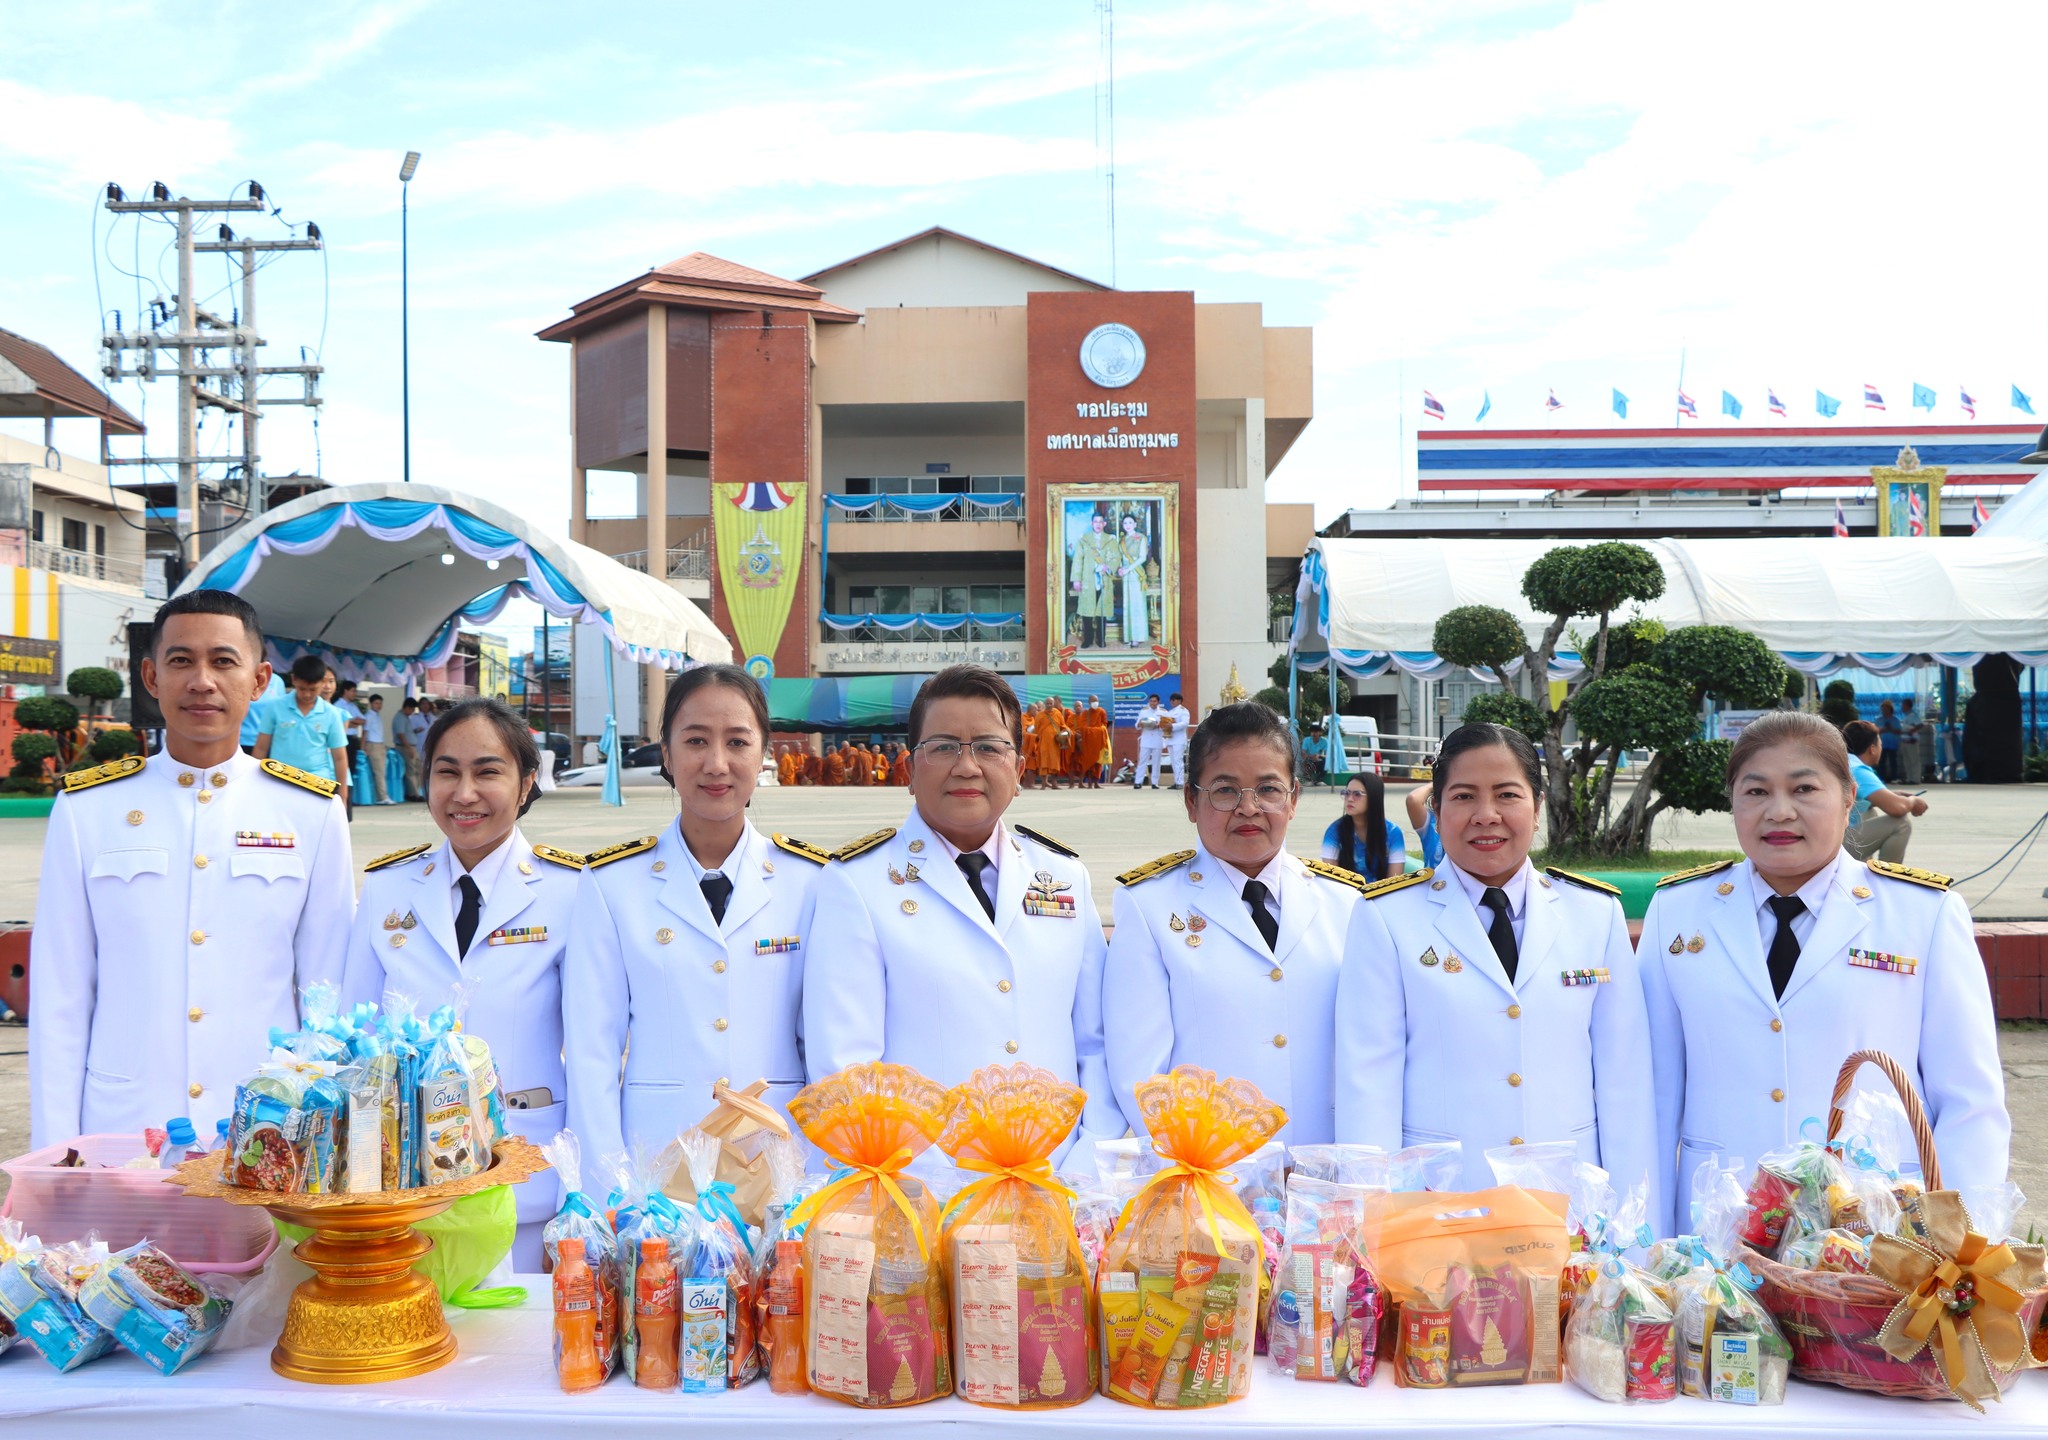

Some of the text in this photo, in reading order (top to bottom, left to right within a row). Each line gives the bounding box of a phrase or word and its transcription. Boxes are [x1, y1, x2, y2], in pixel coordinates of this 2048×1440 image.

[1047, 427, 1178, 457] เทศบาลเมืองชุมพร
[432, 1086, 462, 1107] ดีน่า
[689, 1288, 720, 1309] ดีน่า
[1154, 1314, 1175, 1329] Julie's
